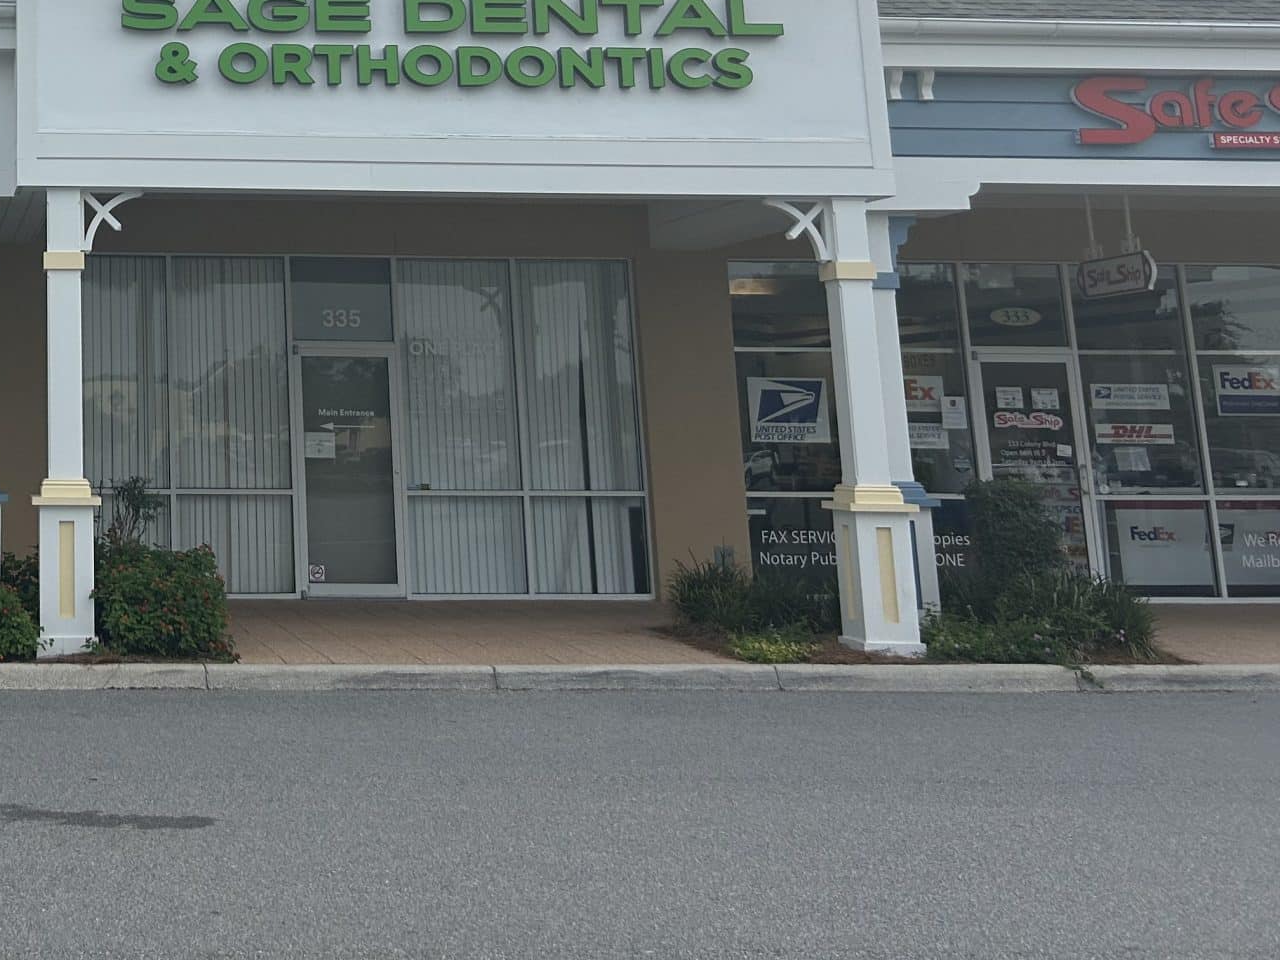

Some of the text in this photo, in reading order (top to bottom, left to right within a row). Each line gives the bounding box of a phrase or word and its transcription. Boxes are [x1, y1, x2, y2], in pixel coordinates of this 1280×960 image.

[155, 41, 753, 89] & ORTHODONTICS
[1072, 75, 1265, 145] Safe
[1220, 135, 1270, 144] SPECIALTY
[322, 309, 361, 328] 335
[1002, 310, 1030, 323] 333
[1220, 371, 1276, 390] FedEx
[318, 408, 375, 417] Main Entrance
[1031, 413, 1061, 428] Ship
[755, 425, 817, 433] UNITED STATES
[1111, 424, 1154, 439] DHL
[754, 433, 807, 441] POST OFFICE
[761, 530, 836, 544] FAX SERVIC
[933, 531, 971, 549] opies
[1130, 525, 1177, 541] FedEx
[1243, 533, 1265, 548] We
[759, 551, 838, 569] Notary Pub
